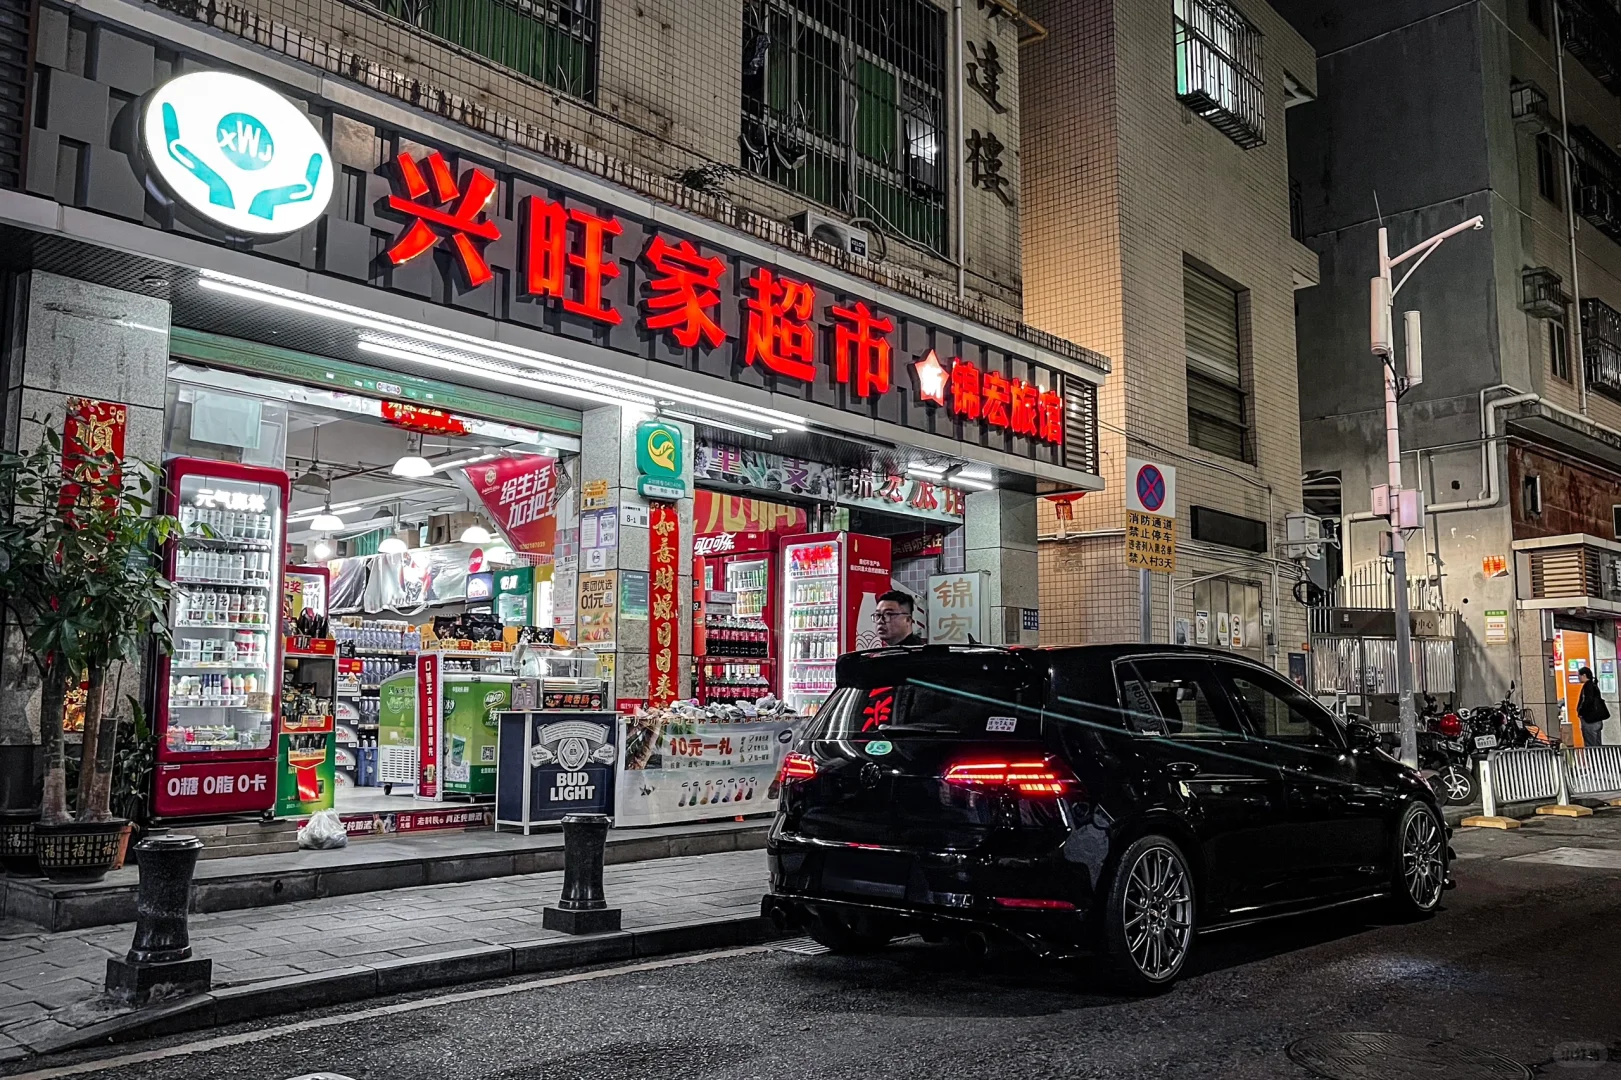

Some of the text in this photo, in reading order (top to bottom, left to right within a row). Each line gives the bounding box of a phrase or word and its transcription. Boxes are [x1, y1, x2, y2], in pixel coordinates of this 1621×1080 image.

[387, 151, 894, 397] 兴旺家超市
[951, 357, 1062, 446] 锦宏旅馆
[499, 465, 551, 505] 给生活
[626, 514, 637, 524] 8-1
[1128, 512, 1173, 531] 消防通道
[1128, 525, 1173, 543] 禁止停车
[694, 532, 736, 556] 可口可乐
[1128, 539, 1173, 556] 违者列入黑名单
[1128, 552, 1173, 569] 禁入村3天
[582, 579, 613, 593] 美团优选
[581, 592, 604, 610] 0.1元
[933, 577, 974, 642] 锦宏
[670, 737, 732, 757] 10元一扎
[167, 773, 267, 796] 0糖 0脂 0卡
[556, 772, 589, 787] BUD
[550, 785, 596, 802] LIGHT
